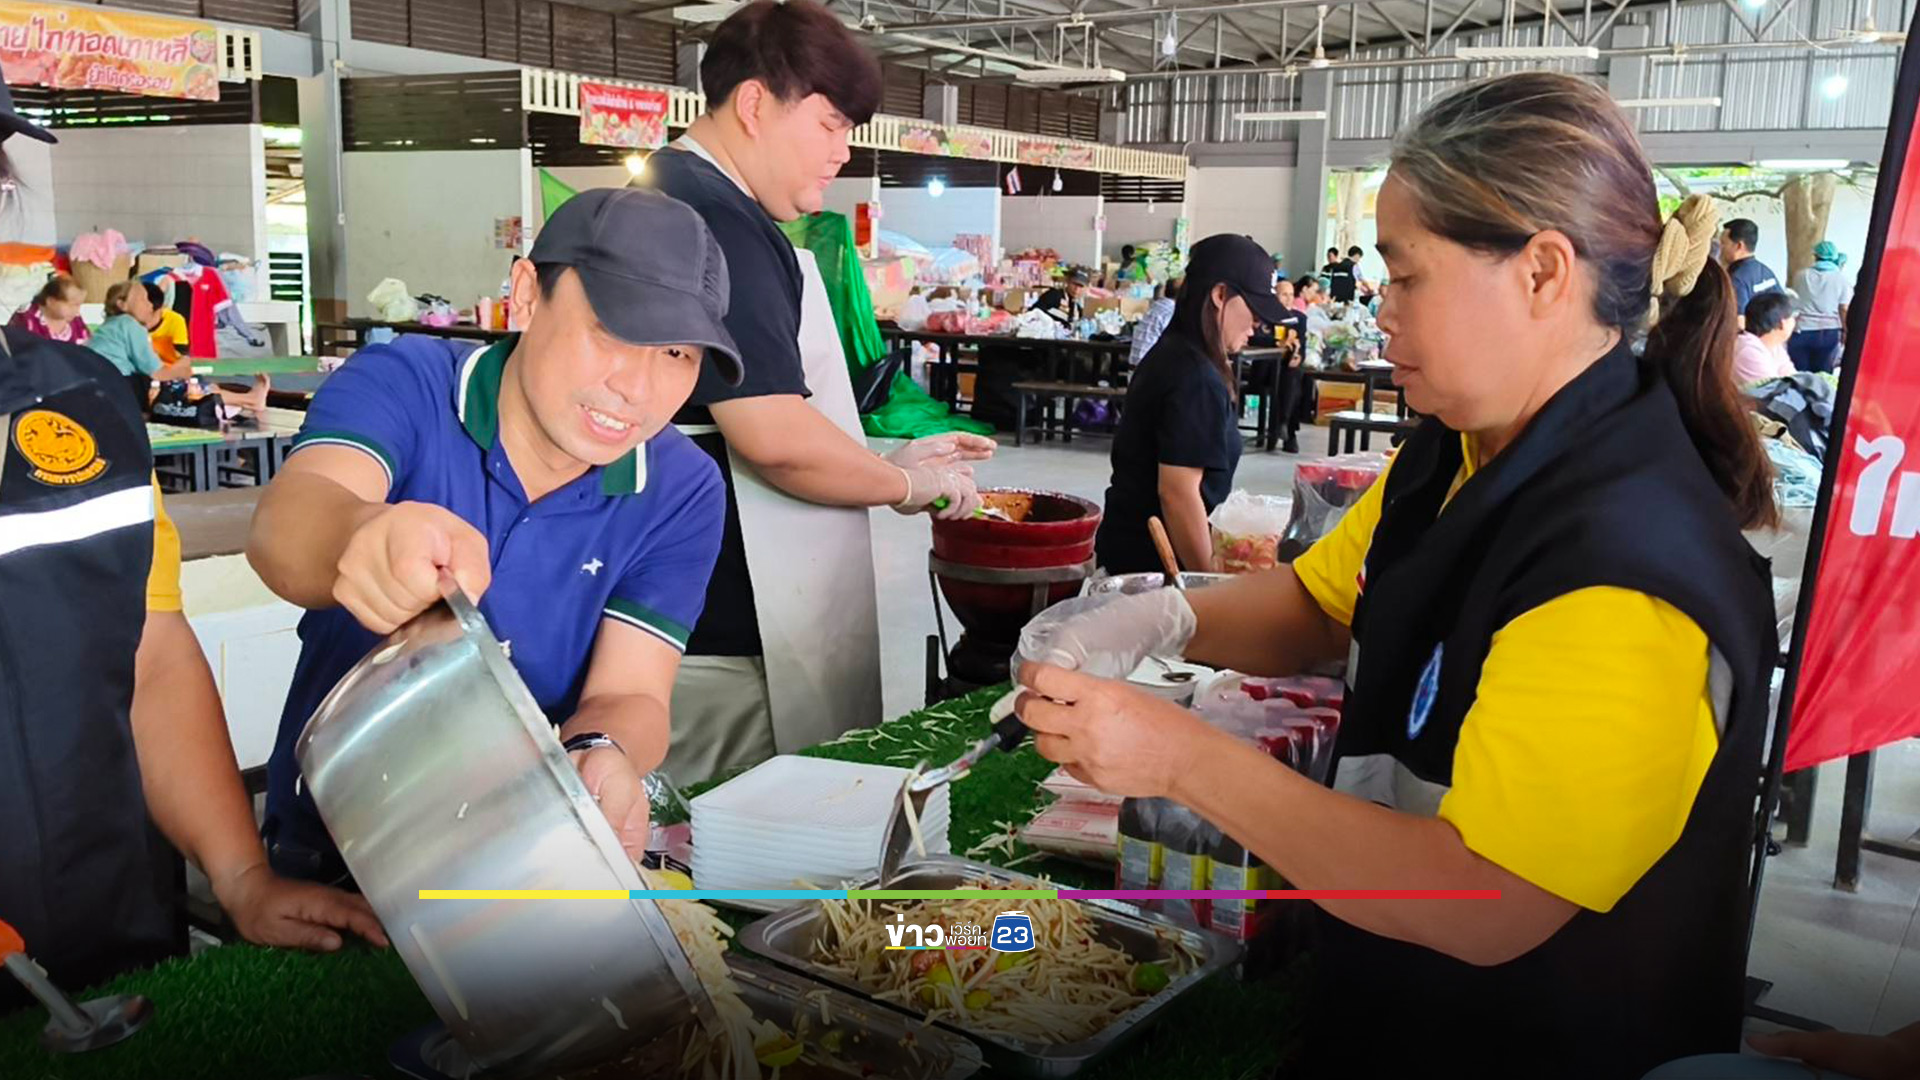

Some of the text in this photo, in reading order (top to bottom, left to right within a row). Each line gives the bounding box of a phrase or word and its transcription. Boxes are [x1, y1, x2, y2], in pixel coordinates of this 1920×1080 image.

[0, 13, 190, 63] ายไก่ทอดเกาหลี
